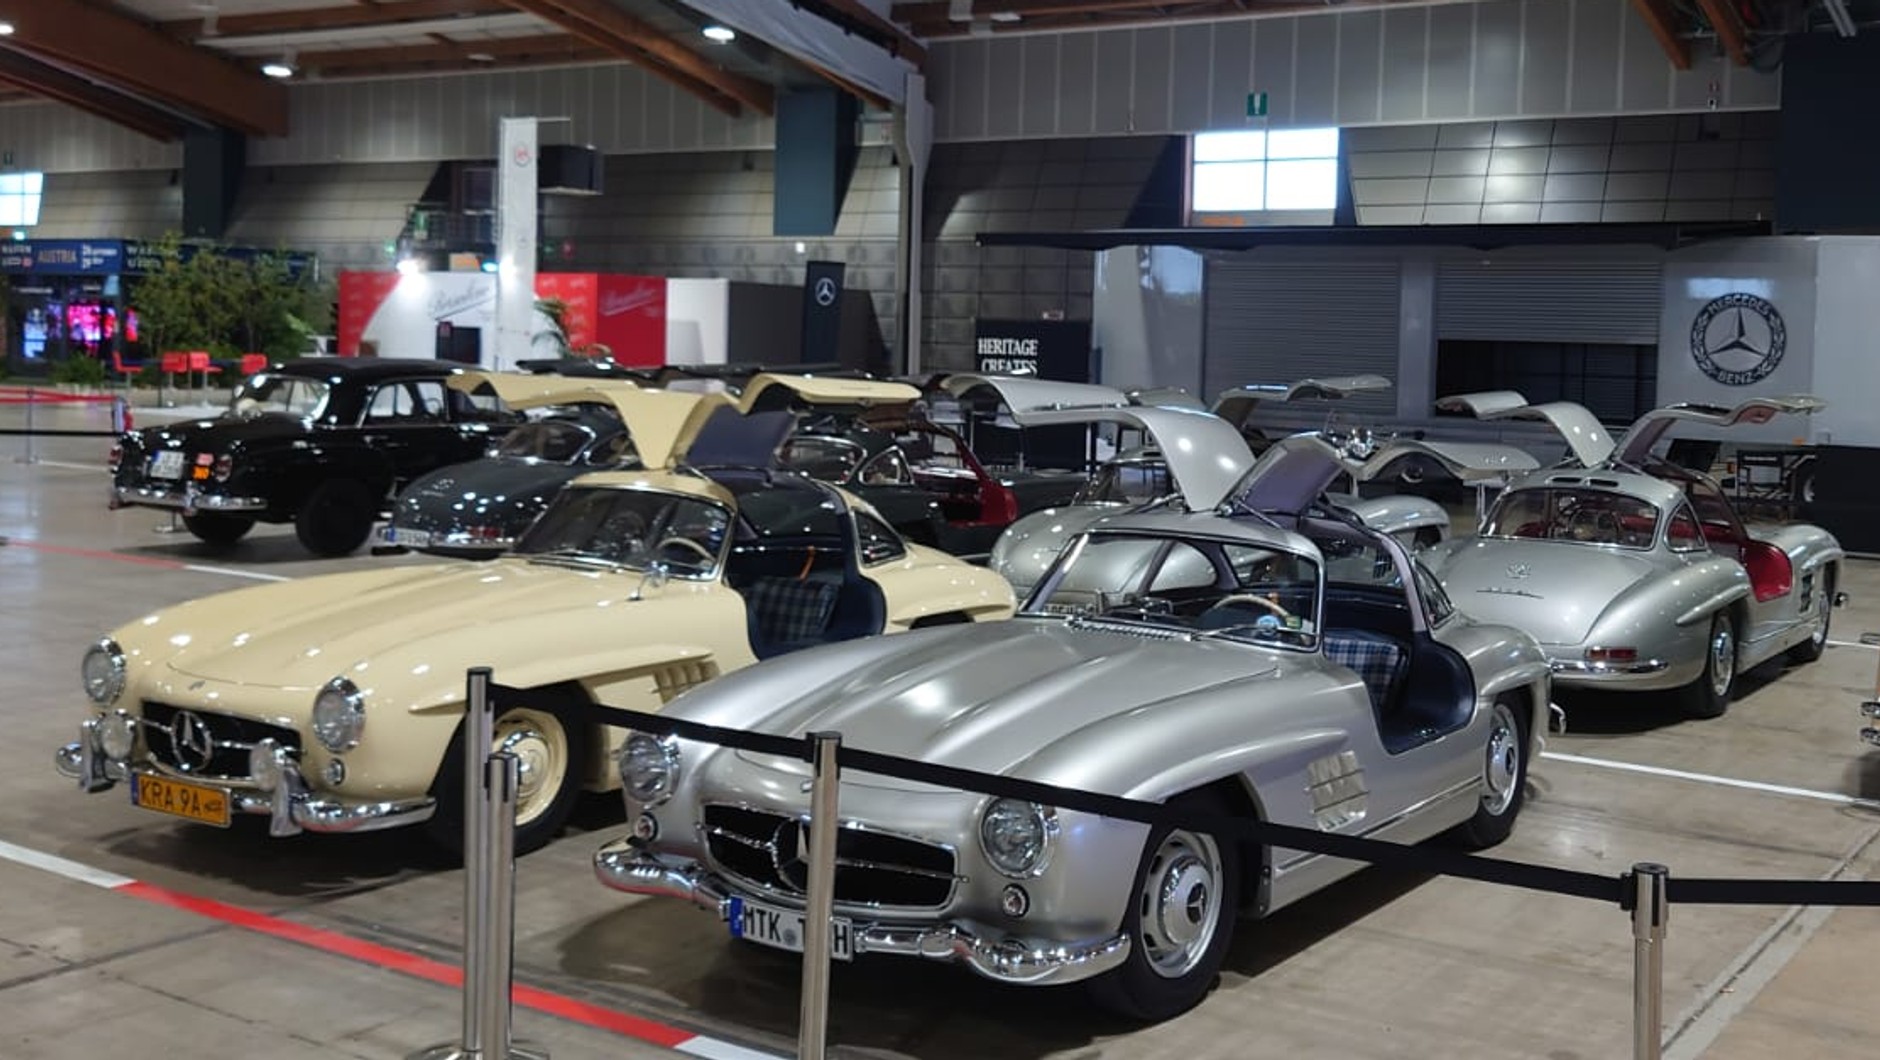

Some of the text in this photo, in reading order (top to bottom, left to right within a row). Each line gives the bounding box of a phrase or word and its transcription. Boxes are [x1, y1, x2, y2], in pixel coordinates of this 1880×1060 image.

[1708, 293, 1770, 316] MERCEDES
[978, 338, 1038, 355] HERITAGE
[1718, 371, 1756, 385] BENZ
[744, 906, 781, 942] MTK
